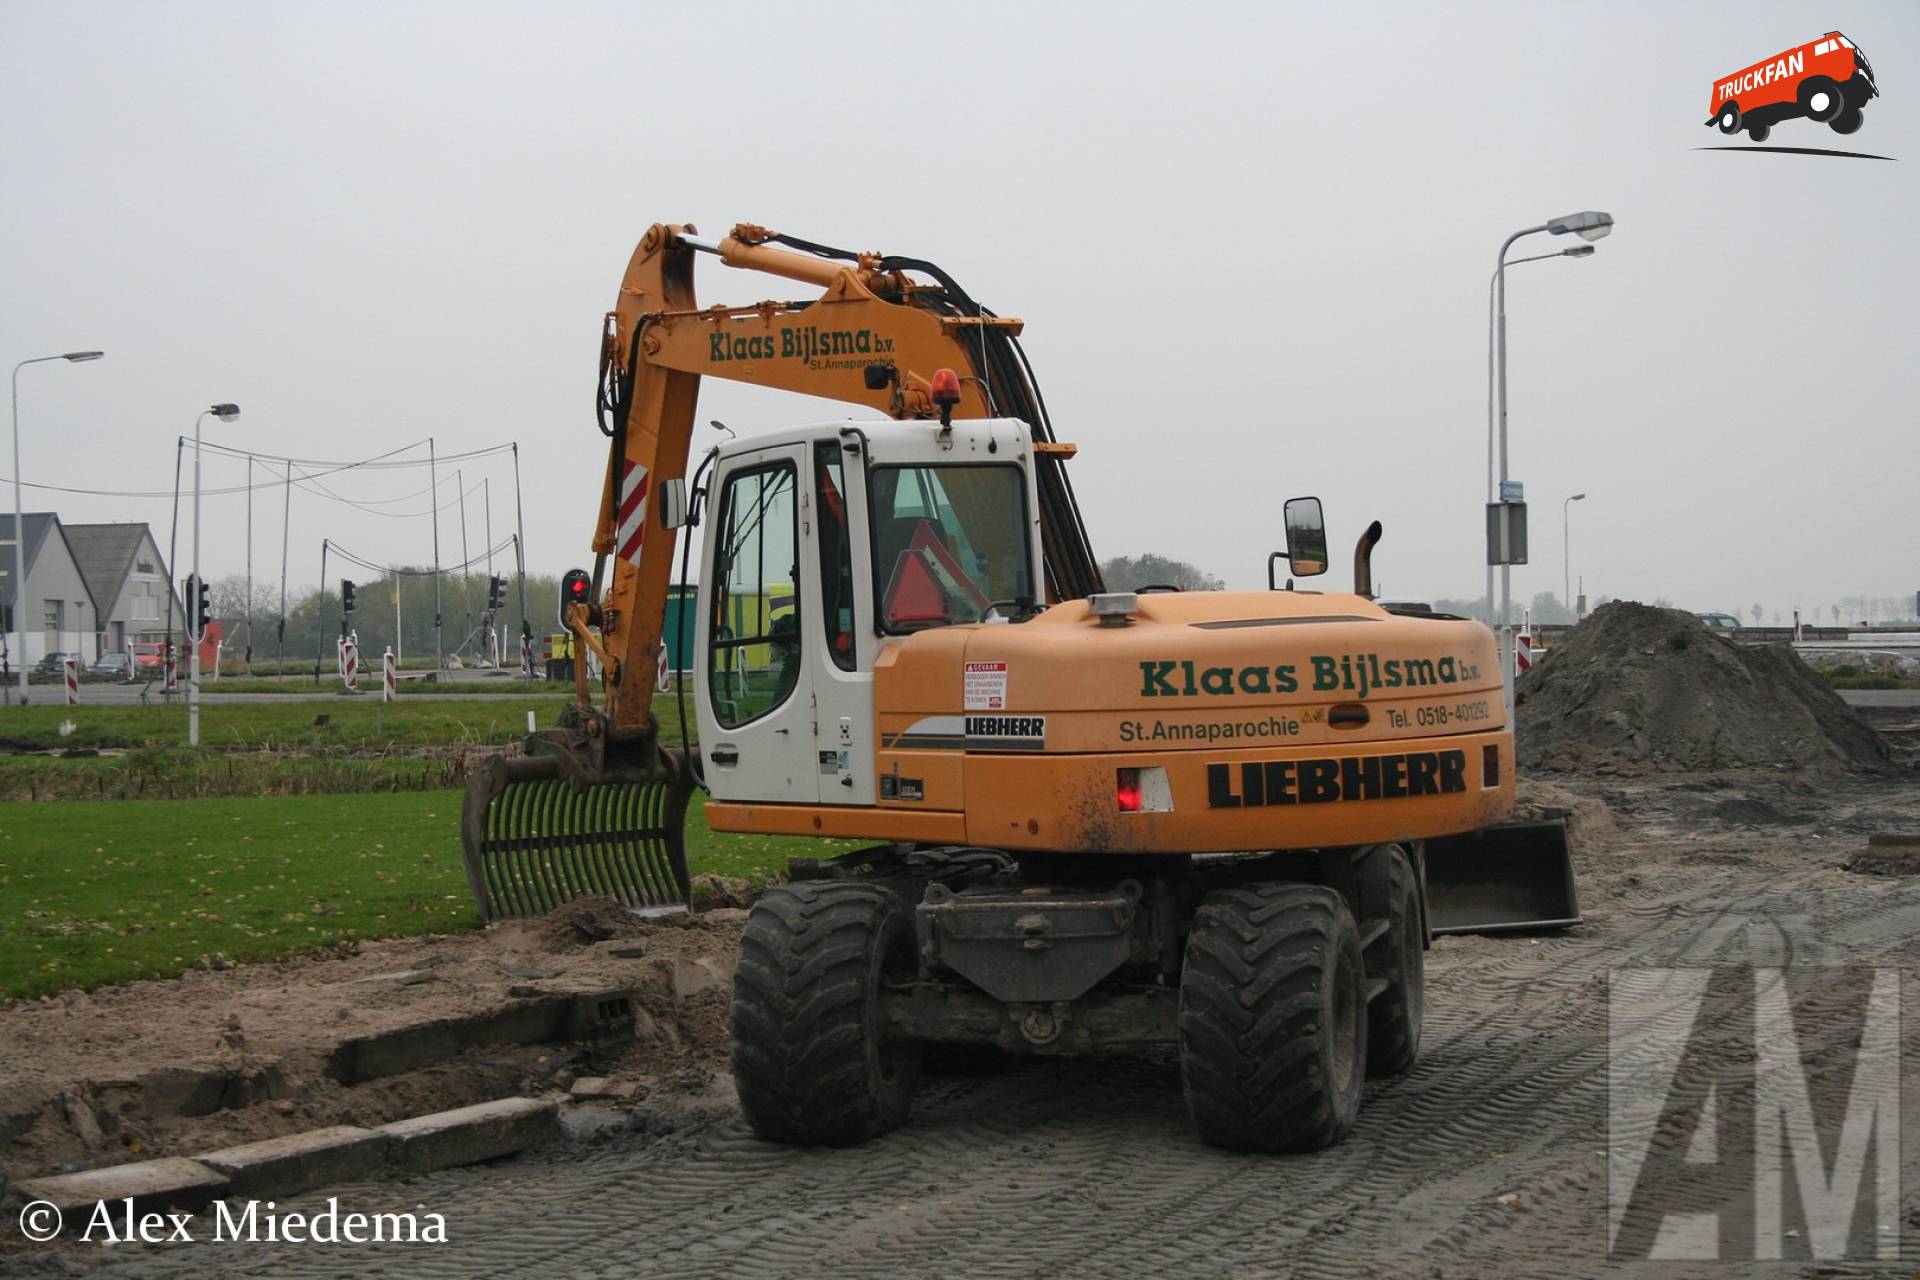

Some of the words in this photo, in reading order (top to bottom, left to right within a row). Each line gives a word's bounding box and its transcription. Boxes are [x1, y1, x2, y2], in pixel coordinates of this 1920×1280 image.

[709, 332, 774, 361] Klaas
[780, 326, 871, 364] Bijlsma
[874, 334, 895, 353] b.v.
[1140, 660, 1298, 697] Klaas
[1310, 653, 1457, 698] Bijlsma
[1458, 659, 1481, 681] b.v.
[966, 717, 1044, 736] LIEBHERR
[1119, 716, 1300, 742] St.Annaparochie
[1386, 709, 1412, 728] Tel.
[1207, 749, 1467, 808] LIEBHERR
